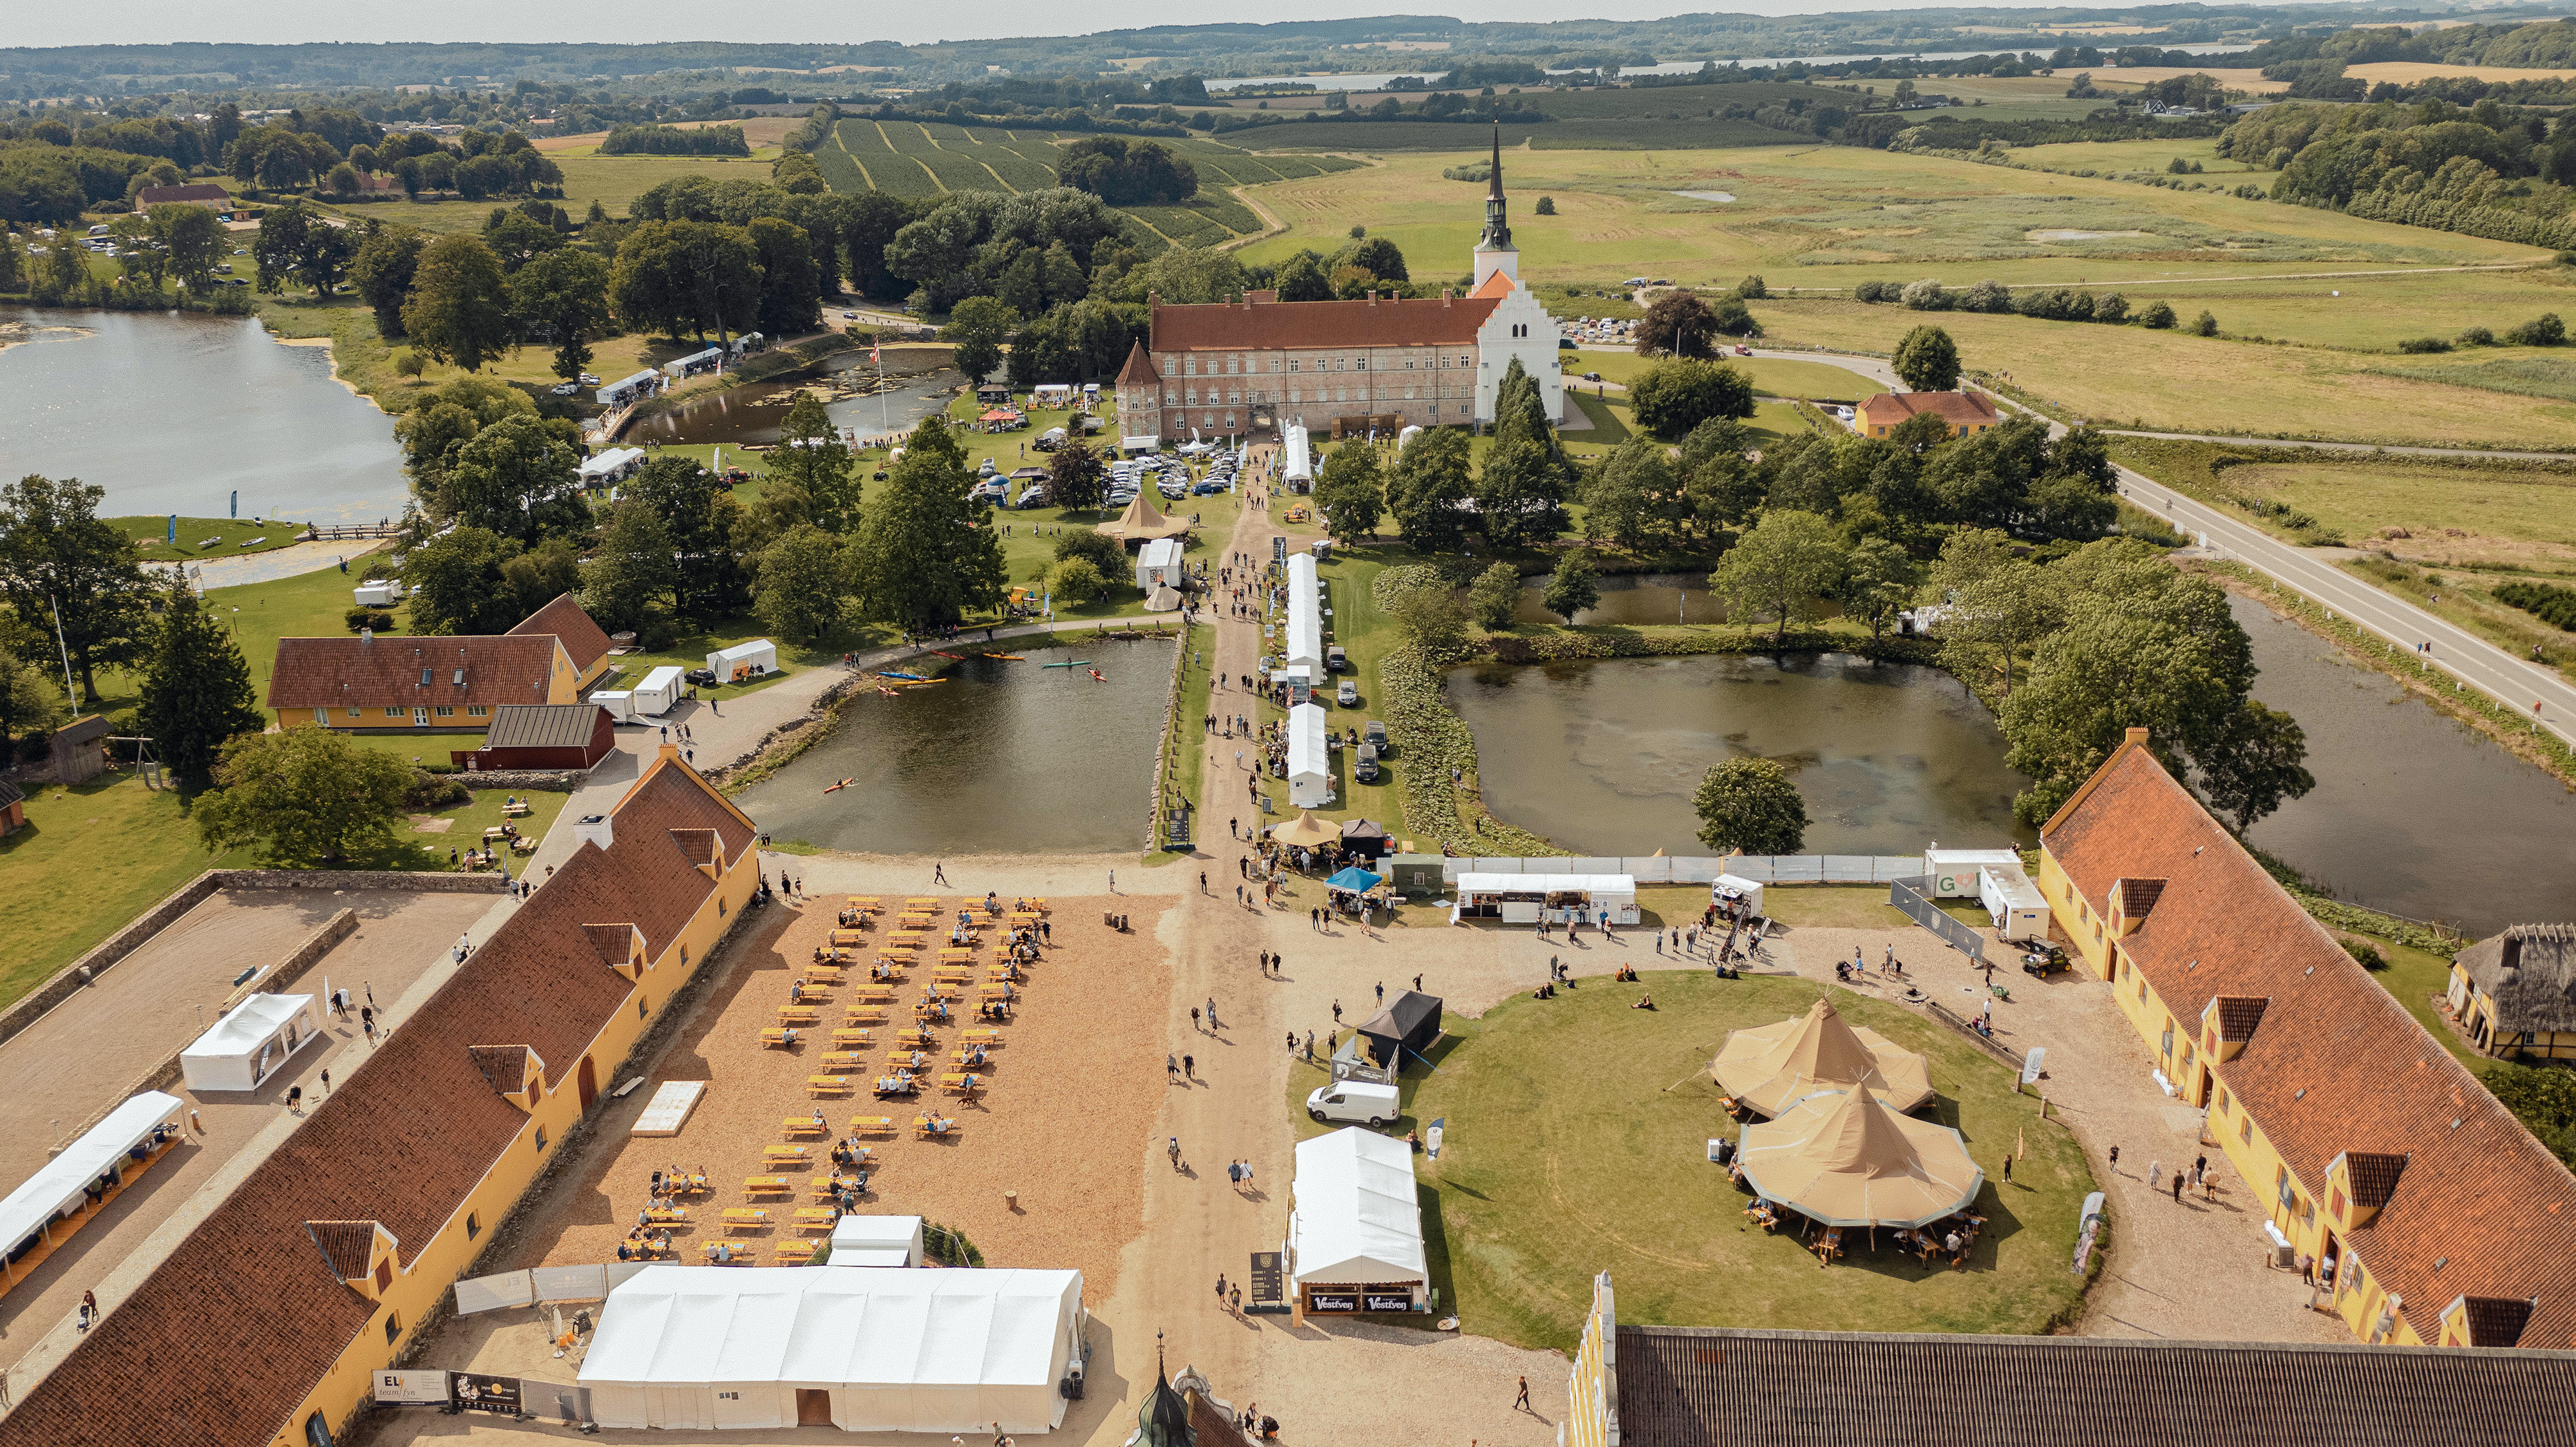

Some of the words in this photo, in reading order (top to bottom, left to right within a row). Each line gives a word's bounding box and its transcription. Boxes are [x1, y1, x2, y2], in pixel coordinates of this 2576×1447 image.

[1314, 1296, 1353, 1310] Vestfyen
[1368, 1297, 1406, 1310] Vestfyen
[384, 1376, 399, 1386] EL
[403, 1388, 415, 1397] fyn
